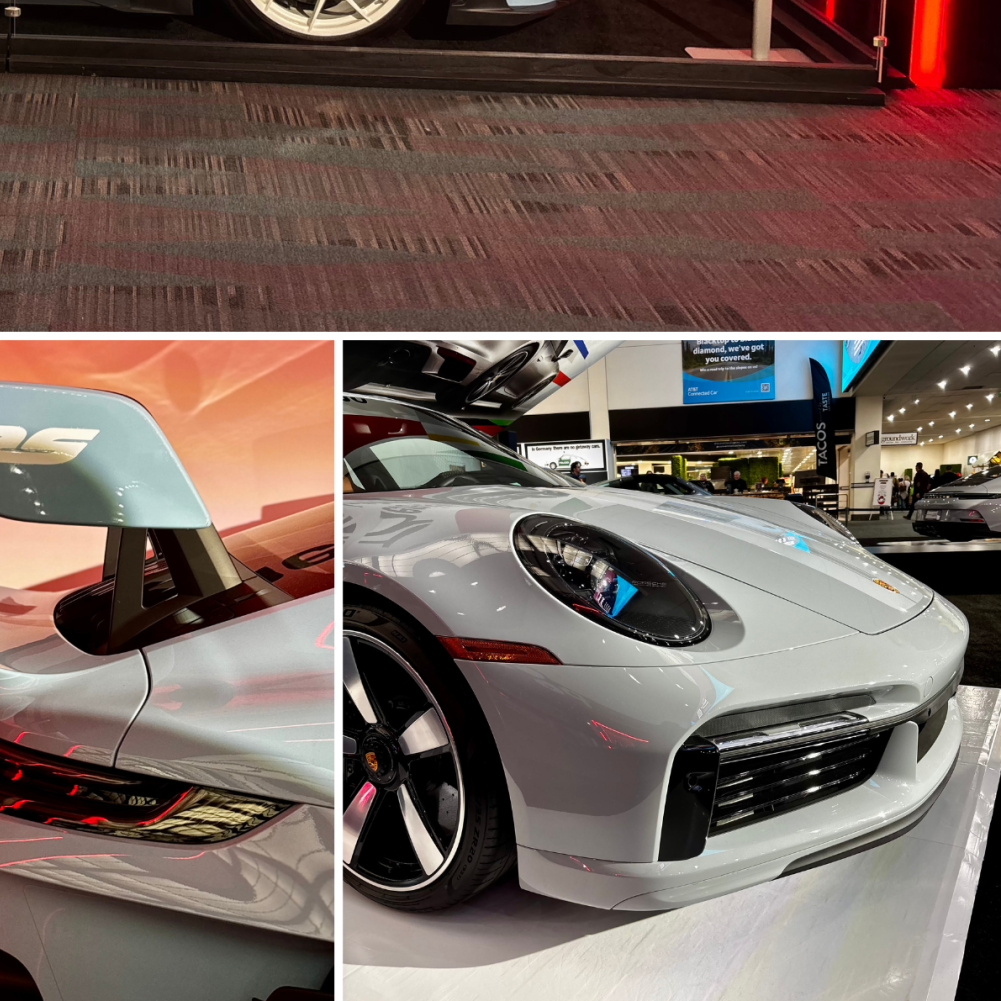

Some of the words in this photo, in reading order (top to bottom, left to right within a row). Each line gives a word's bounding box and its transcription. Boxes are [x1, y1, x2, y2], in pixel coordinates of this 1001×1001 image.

[693, 346, 727, 354] diamond,
[727, 344, 750, 353] we've
[750, 343, 765, 353] got
[705, 356, 719, 365] you
[720, 353, 752, 362] covered.
[816, 421, 828, 467] TACOS
